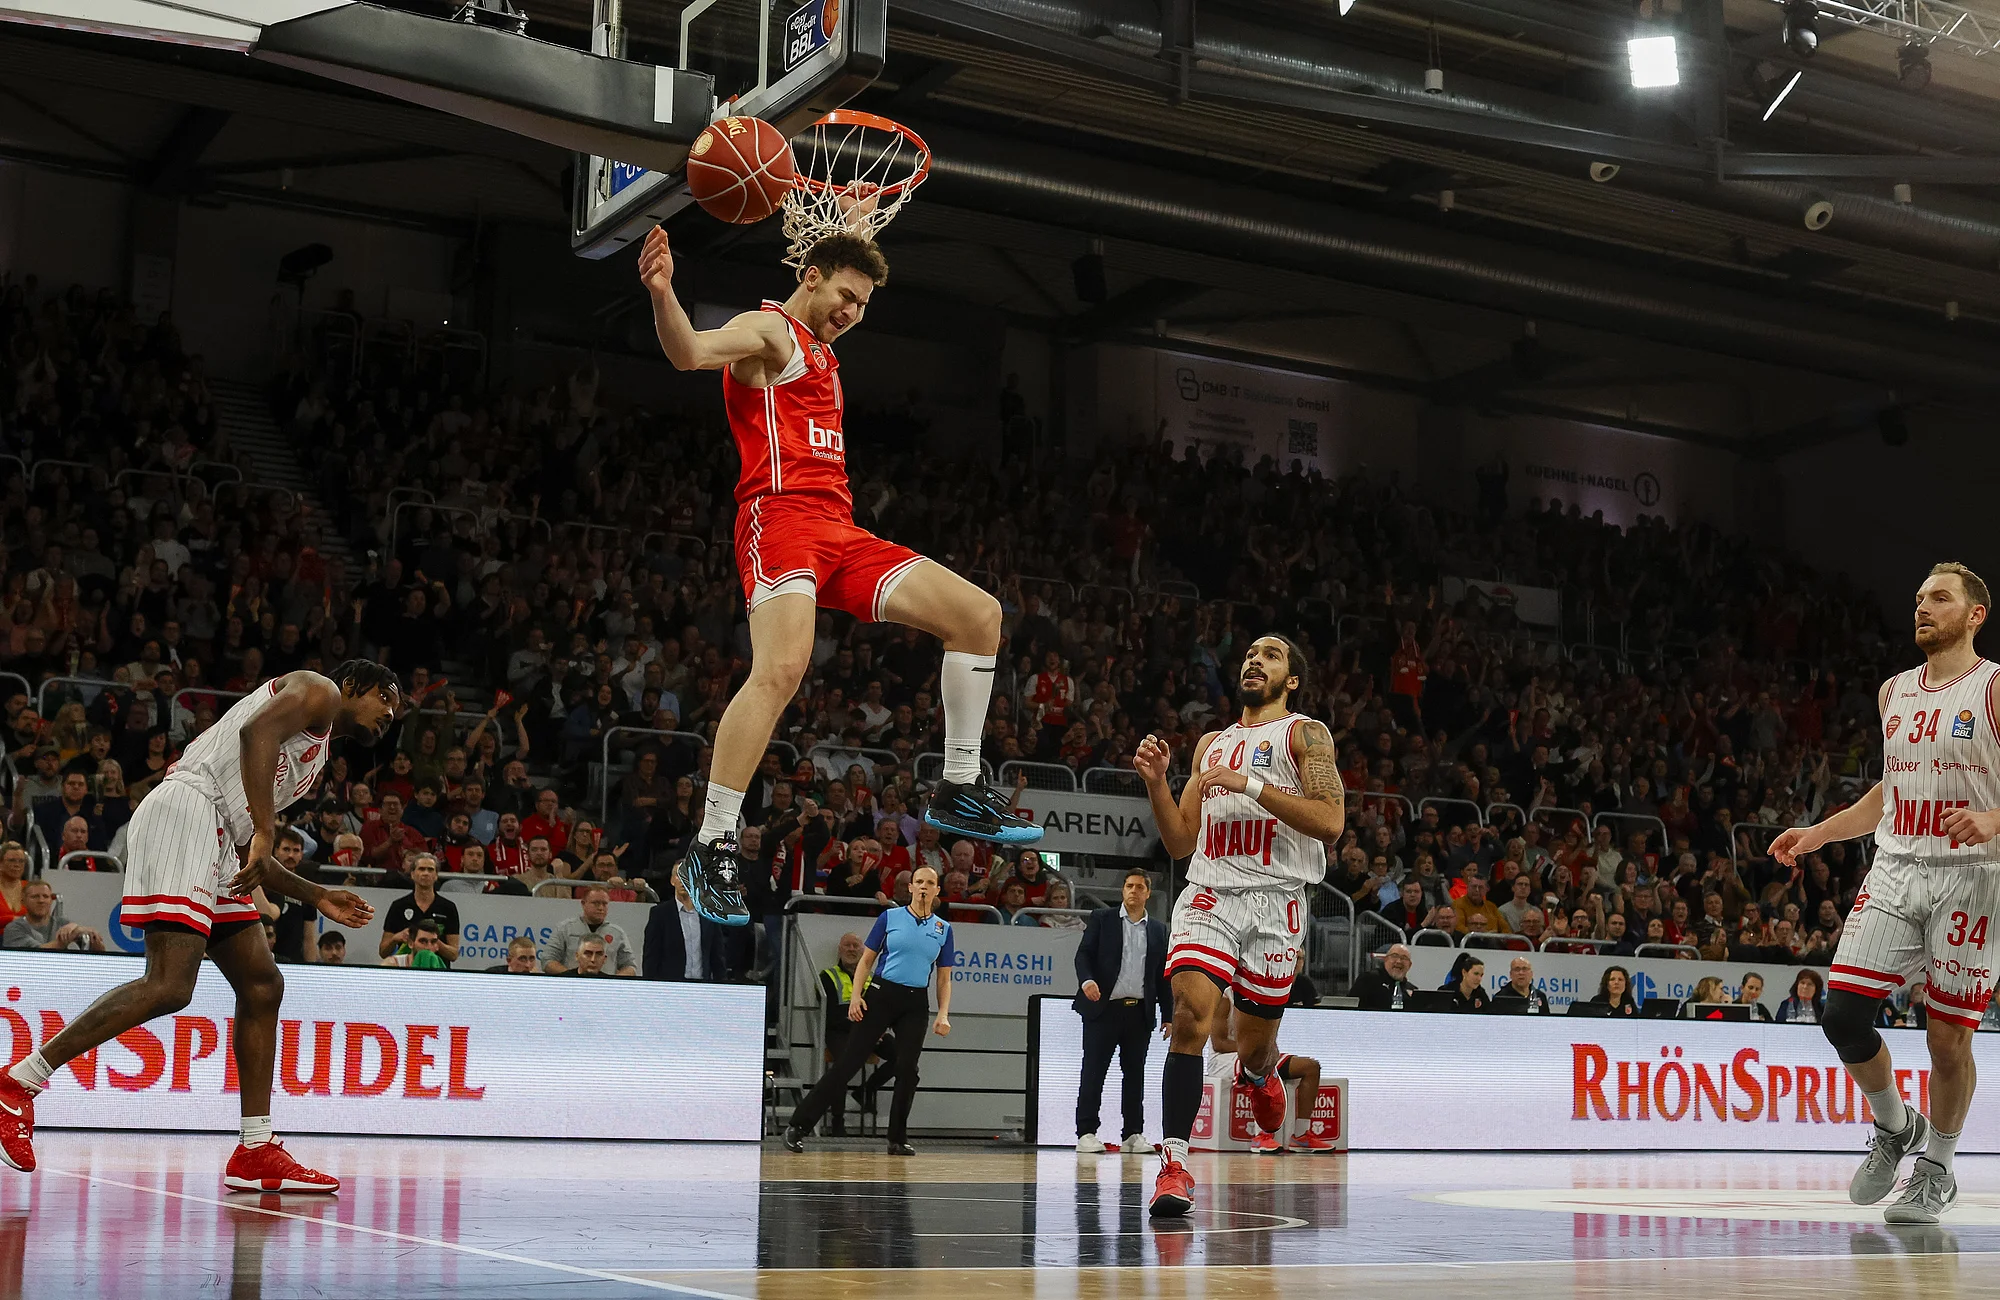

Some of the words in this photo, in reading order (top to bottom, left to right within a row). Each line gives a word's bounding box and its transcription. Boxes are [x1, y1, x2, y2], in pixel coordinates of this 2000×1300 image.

[790, 12, 807, 30] easy
[790, 29, 815, 64] BBL
[1296, 396, 1331, 412] GmbH
[1908, 708, 1942, 744] 34
[1953, 729, 1971, 738] BBL
[1229, 740, 1246, 771] 0
[1942, 762, 1988, 775] SPRINTIS
[1043, 811, 1146, 838] ARENA
[1286, 899, 1300, 934] 0
[463, 923, 553, 945] GARAS
[1947, 911, 1989, 951] 34
[952, 950, 1052, 971] GARASHI
[1013, 974, 1052, 985] GMBH
